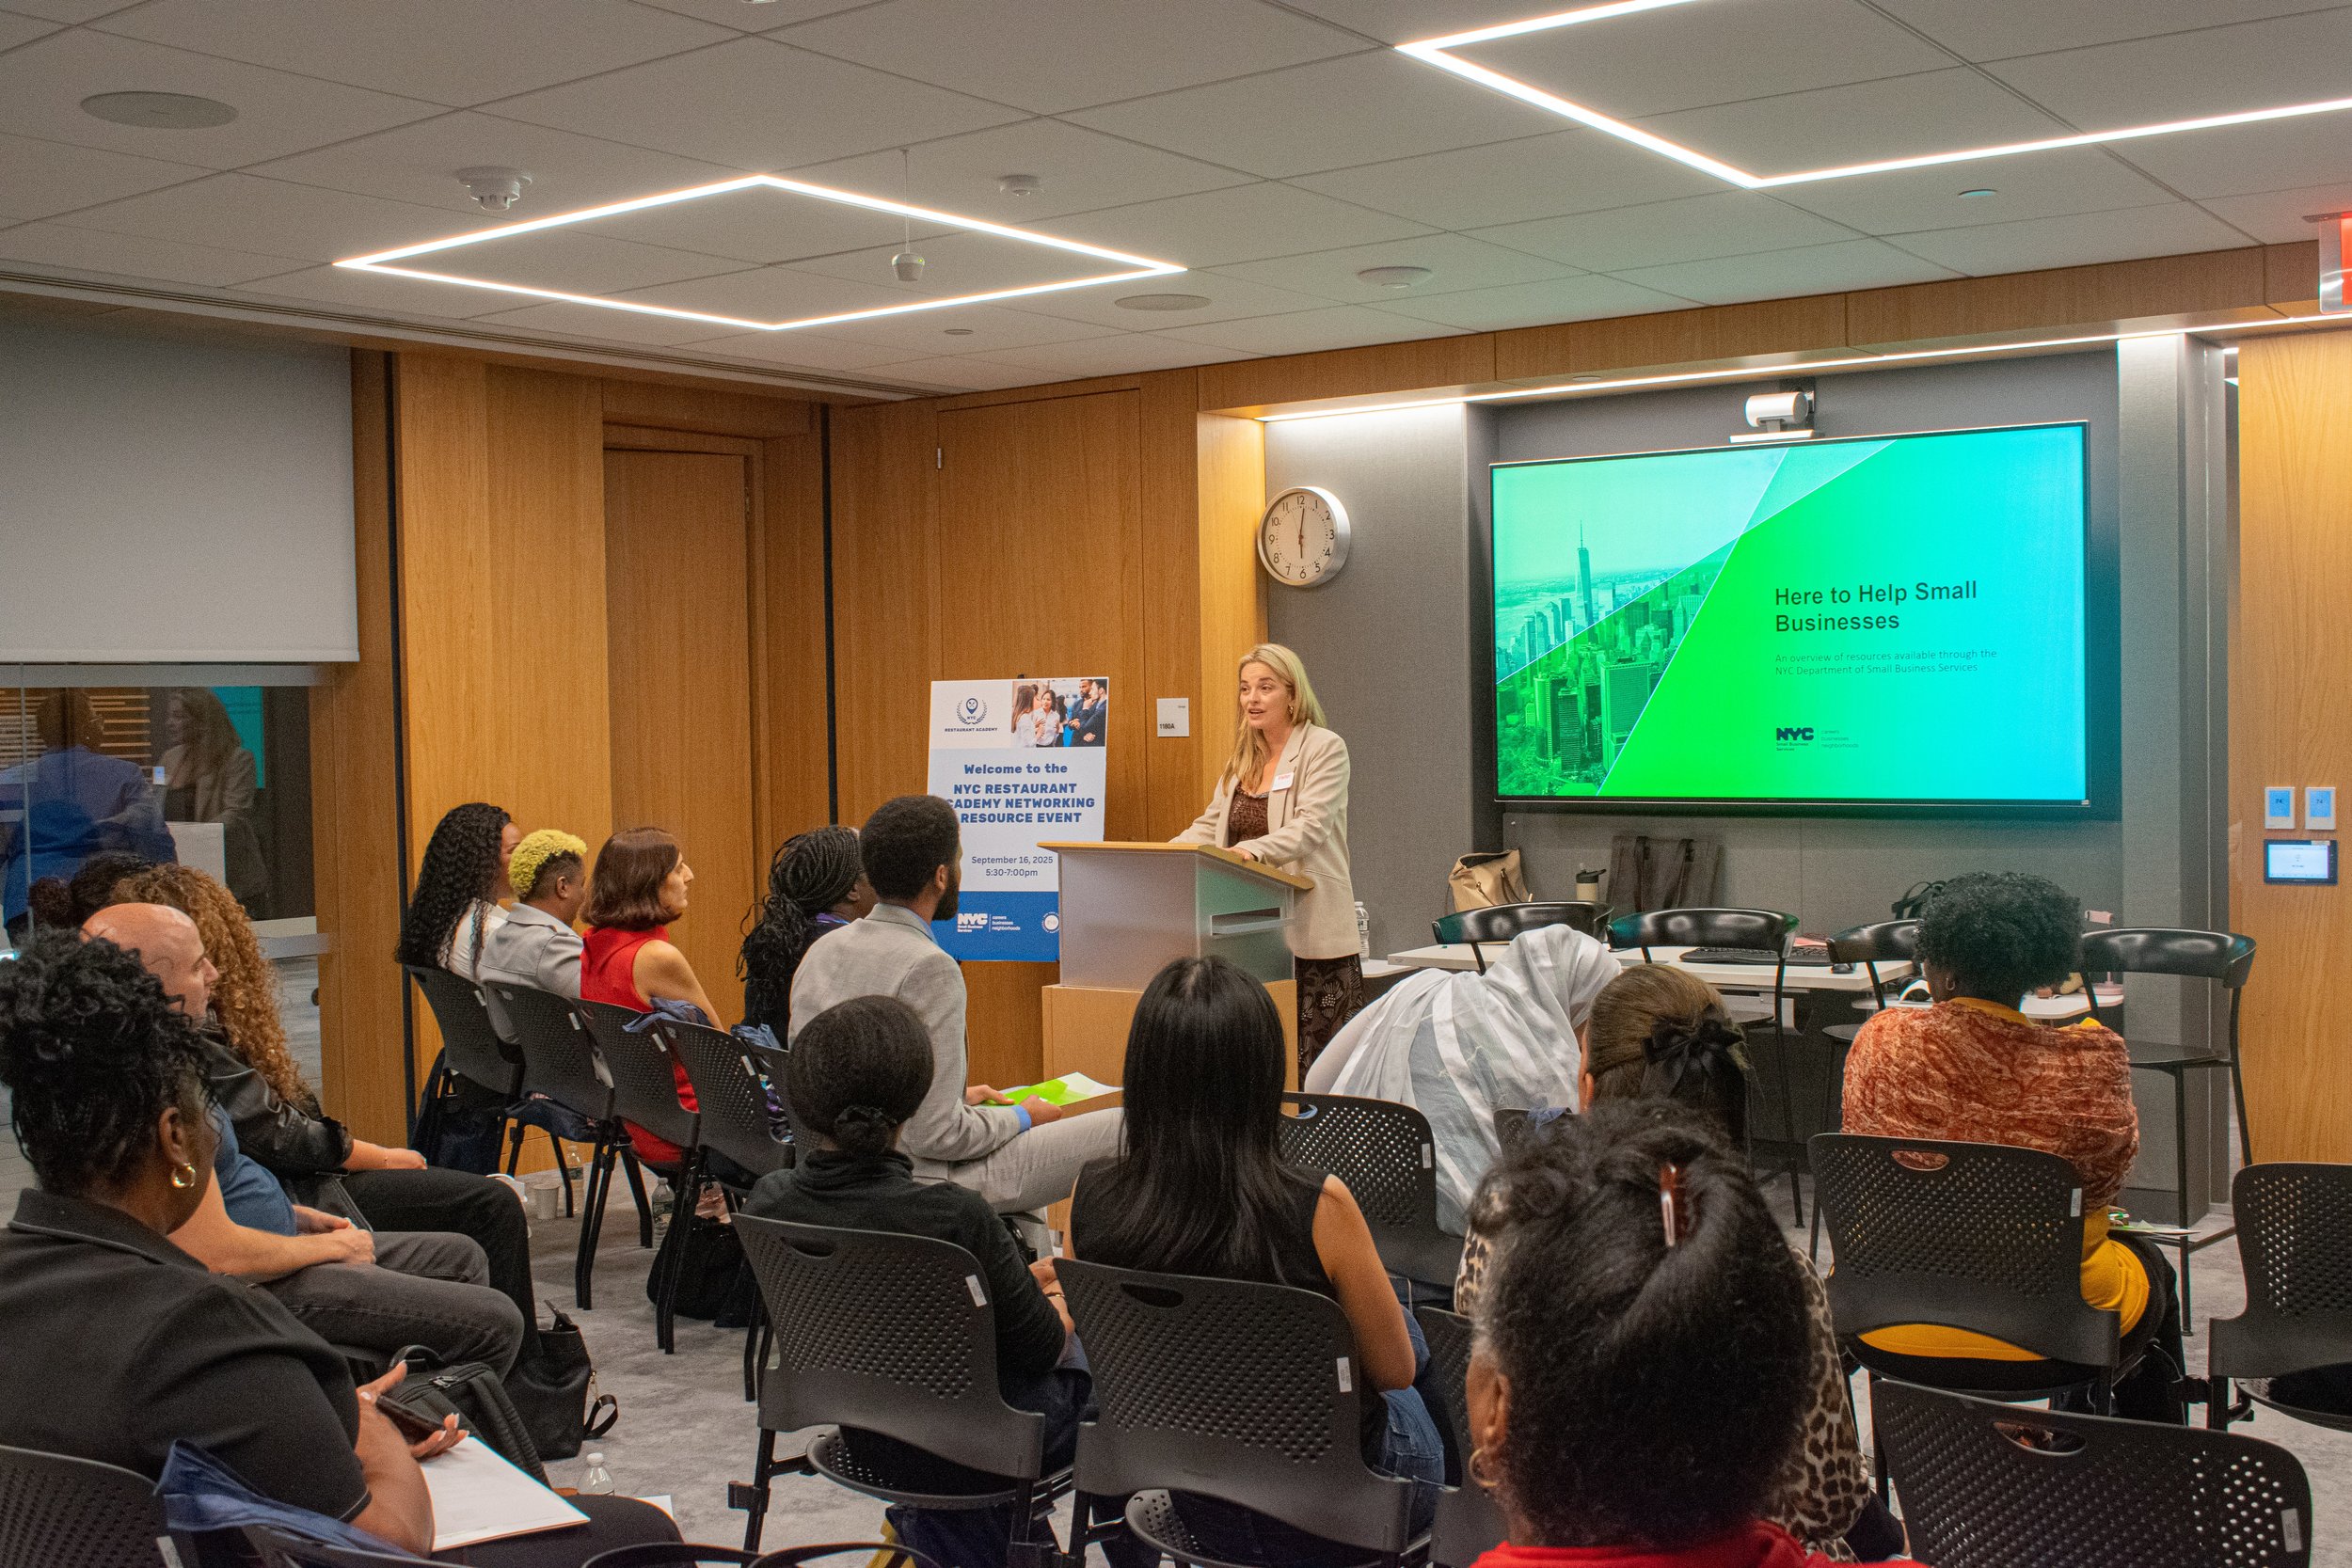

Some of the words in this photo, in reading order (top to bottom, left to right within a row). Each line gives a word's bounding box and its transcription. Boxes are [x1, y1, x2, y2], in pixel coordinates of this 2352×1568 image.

[1296, 496, 1305, 505] 12
[1282, 502, 1288, 511] 11
[1326, 511, 1331, 520] 2
[1271, 516, 1279, 527] 10
[1268, 534, 1275, 545] 9
[1329, 530, 1335, 540] 3
[1325, 547, 1331, 557] 4
[1273, 552, 1279, 563] 8
[1285, 566, 1291, 576] 7
[1315, 562, 1321, 573] 5
[1299, 568, 1307, 578] 6
[1775, 587, 1823, 606] Here
[1831, 587, 1851, 604] to
[1859, 583, 1907, 606] Help
[1915, 580, 1977, 601] Small
[1775, 613, 1899, 632] Businesses
[1775, 654, 1788, 662] An
[1835, 652, 1844, 661] of
[1847, 653, 1892, 661] resources
[1895, 651, 1936, 659] available
[1939, 650, 1978, 660] through
[1980, 649, 1997, 658] the
[1775, 667, 1794, 675] NYC
[1796, 666, 1851, 676] Department
[1854, 665, 1864, 673] of
[1867, 665, 1892, 673] Small
[1895, 664, 1936, 673] Business
[1938, 663, 1978, 673] Services
[1776, 727, 1814, 740] NYC
[964, 764, 1023, 774] Welcome
[1025, 764, 1041, 773] to
[1044, 763, 1068, 773] the
[953, 784, 981, 794] NYC
[985, 784, 1077, 794] RESTAURANT
[946, 799, 1002, 808] CADEMY
[1005, 798, 1095, 808] NETWORKING
[961, 813, 1033, 823] RESOURCE
[1037, 813, 1082, 822] EVENT
[971, 856, 1017, 864] September
[1019, 856, 1031, 864] 16,
[985, 868, 1039, 878] 5:30-7:00pm
[958, 913, 988, 925] NYC
